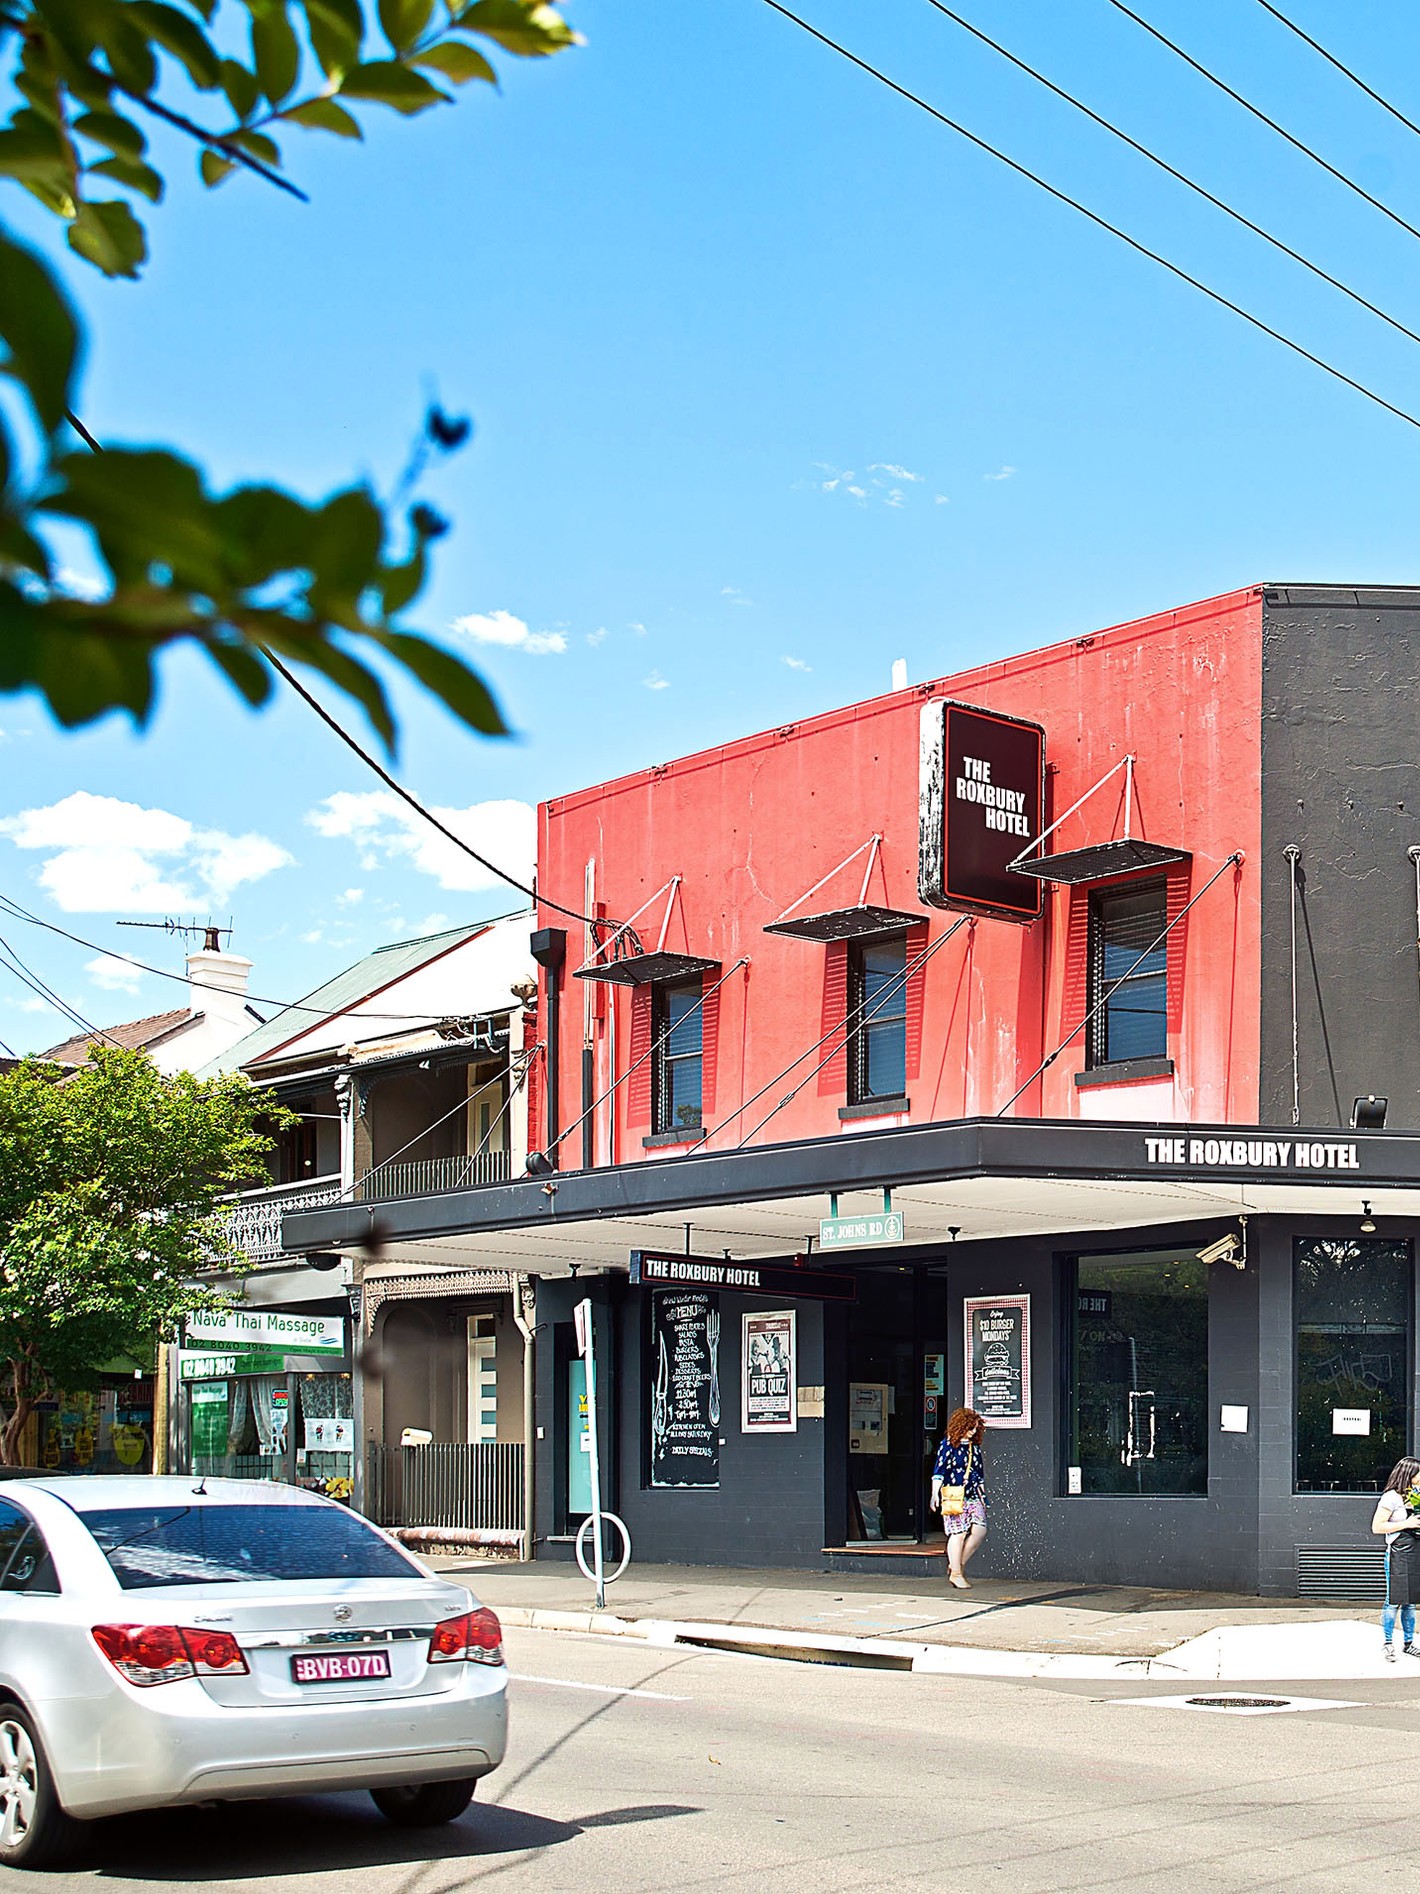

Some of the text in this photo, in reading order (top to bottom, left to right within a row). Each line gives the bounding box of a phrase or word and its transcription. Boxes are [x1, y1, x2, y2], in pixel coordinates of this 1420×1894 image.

[963, 756, 991, 783] THE
[956, 777, 1026, 814] ROXBURY
[985, 806, 1030, 838] HOTEL
[1144, 1138, 1360, 1169] THE ROXBURY HOTEL
[822, 1221, 883, 1241] ST. JOHNS RD
[646, 1259, 760, 1286] THE ROXBURY HOTEL
[193, 1309, 325, 1336] Nava Thai Massage
[990, 1318, 1014, 1330] BURGER
[190, 1340, 272, 1352] 02 8040 3942
[752, 1378, 786, 1396] PUB QUIZ
